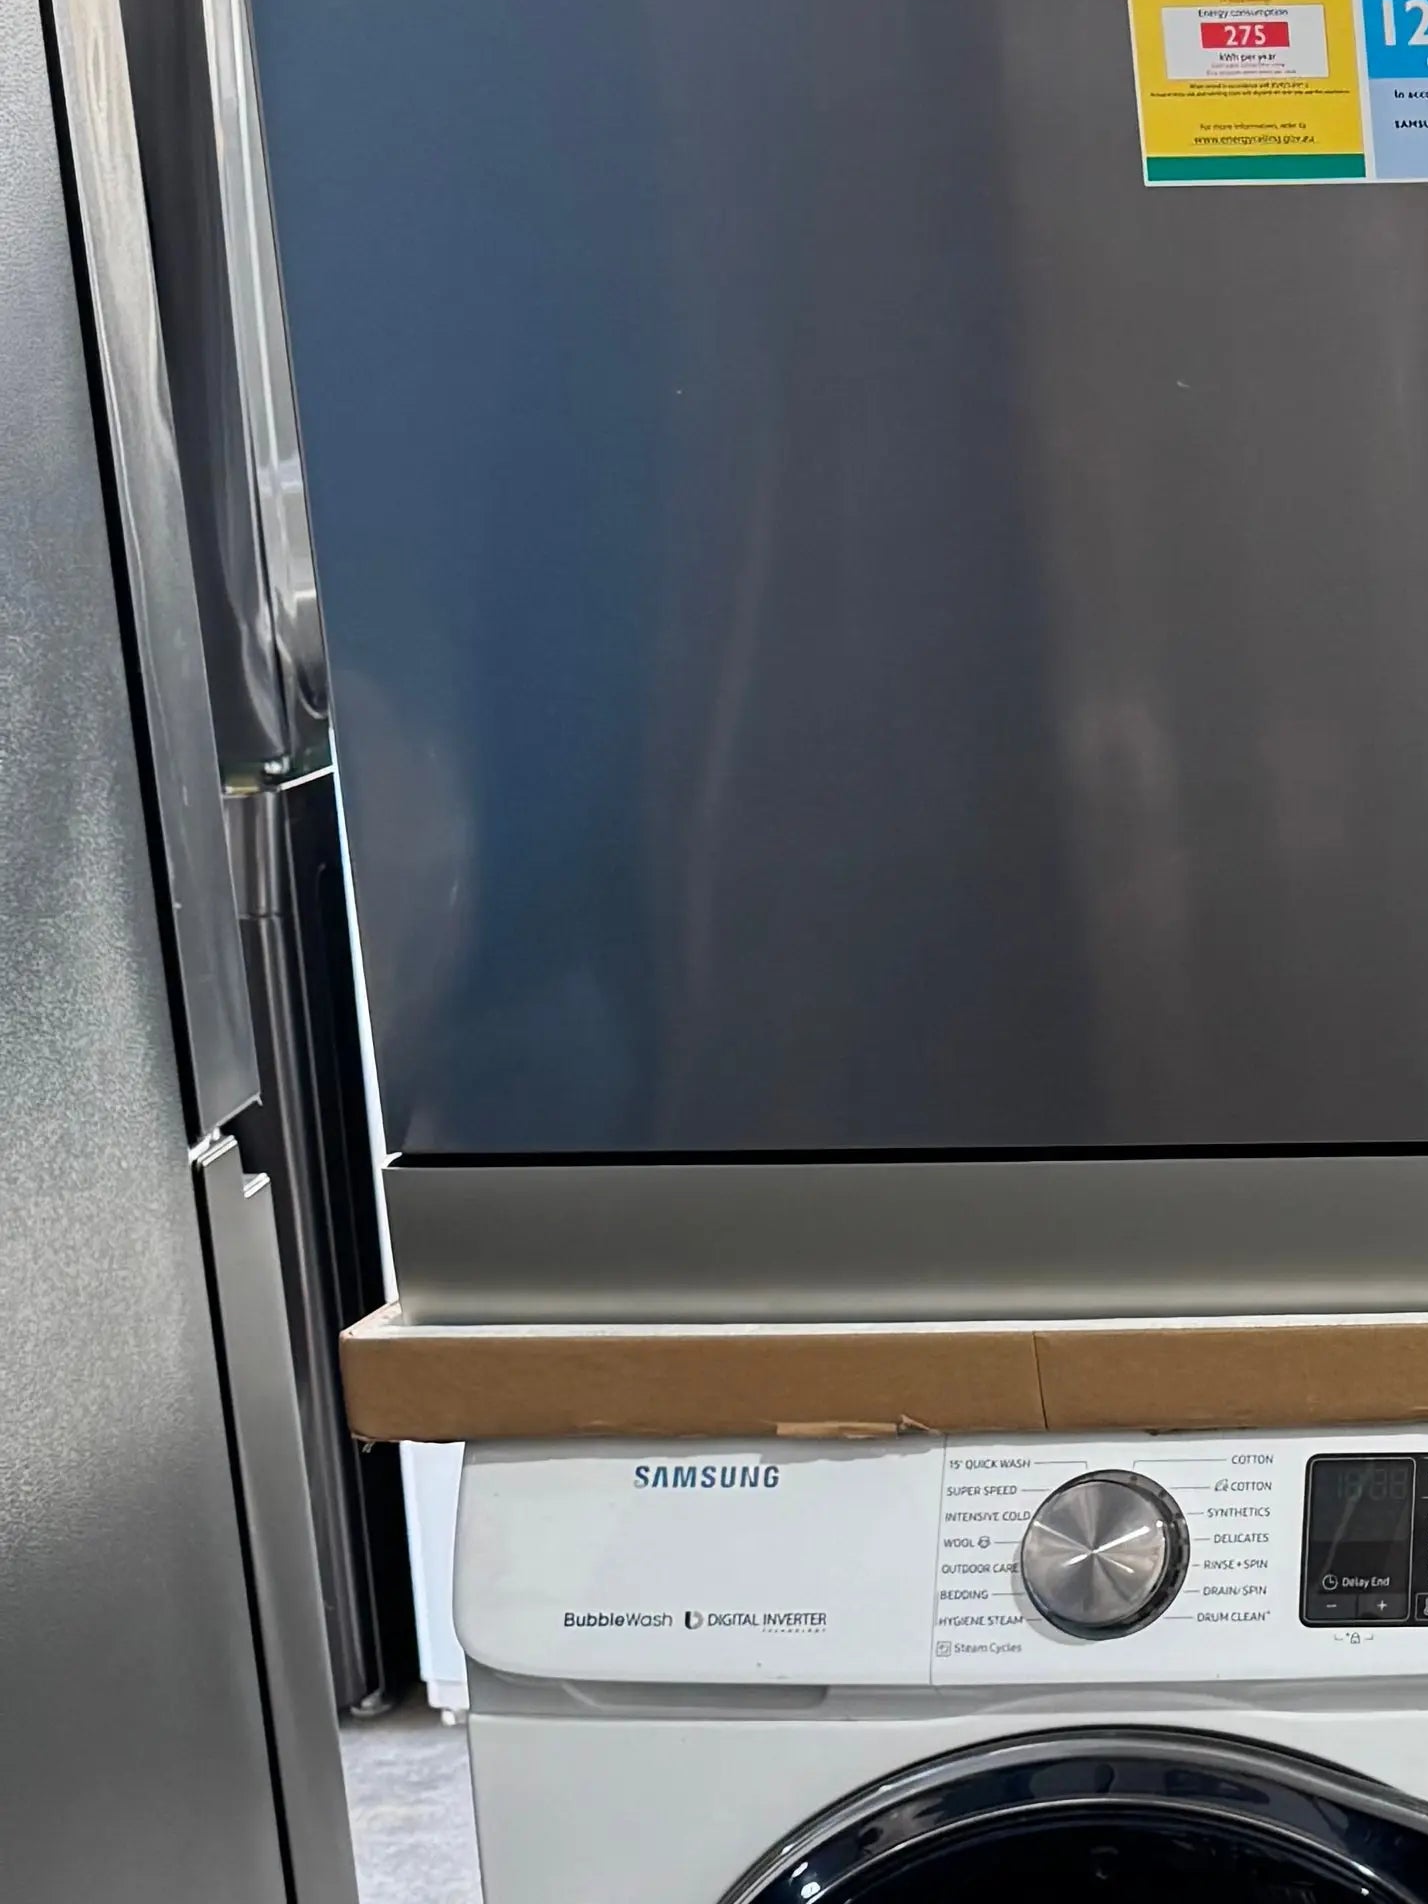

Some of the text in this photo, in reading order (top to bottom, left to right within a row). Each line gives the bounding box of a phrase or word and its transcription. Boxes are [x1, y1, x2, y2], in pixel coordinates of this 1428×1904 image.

[1198, 8, 1288, 19] Energy consumption
[1223, 24, 1266, 46] 275
[1219, 52, 1240, 62] kWh
[1241, 53, 1256, 63] per
[1394, 89, 1405, 99] In
[965, 1458, 1031, 1470] QUICK WASH
[1231, 1454, 1274, 1465] COTTON
[633, 1465, 780, 1489] SAMSUNG
[947, 1485, 1018, 1496] SUPER SPEED
[1230, 1481, 1273, 1491] COTTON
[945, 1511, 1031, 1522] INTENSIVE COLD
[1207, 1507, 1271, 1518] SYNTHETICS
[943, 1537, 974, 1548] WOOL
[1213, 1533, 1269, 1544] DELICATES
[941, 1562, 1020, 1574] OUTDOOR CARE
[1203, 1559, 1269, 1570] RINSE SPIN
[1342, 1576, 1390, 1588] Delay End
[940, 1590, 989, 1600] BEDDING
[564, 1611, 827, 1628] BubbleWash DIGITAL INVERTER
[938, 1615, 1024, 1627] HYGIENE STEAM
[1197, 1612, 1229, 1622] DRUM
[954, 1642, 1022, 1654] Steam Cycles
